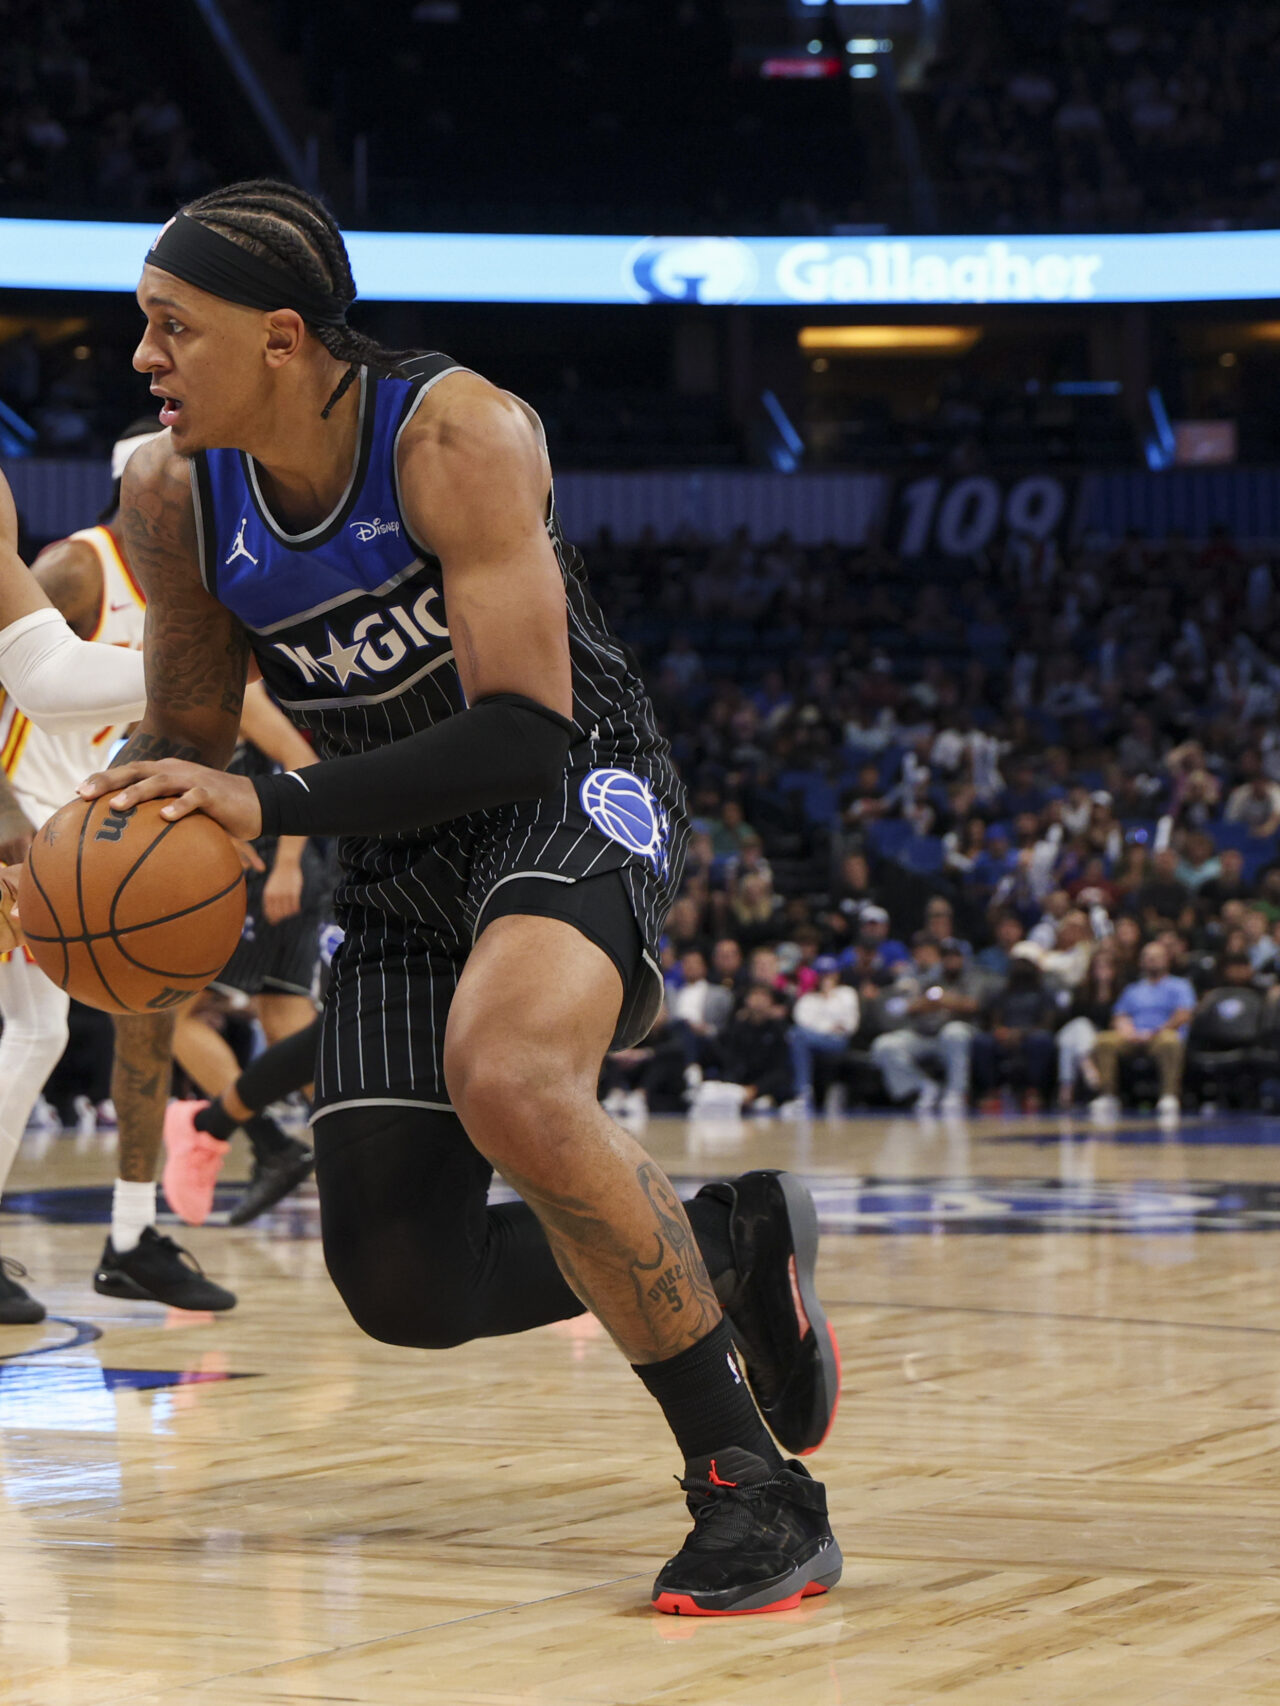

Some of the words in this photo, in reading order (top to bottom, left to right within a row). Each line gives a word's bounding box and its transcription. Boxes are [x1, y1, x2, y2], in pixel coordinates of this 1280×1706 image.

[776, 242, 1102, 304] Gallagher
[349, 517, 400, 543] Disney
[899, 474, 1065, 557] 109
[647, 1263, 684, 1302] DUKE
[665, 1287, 684, 1313] 5
